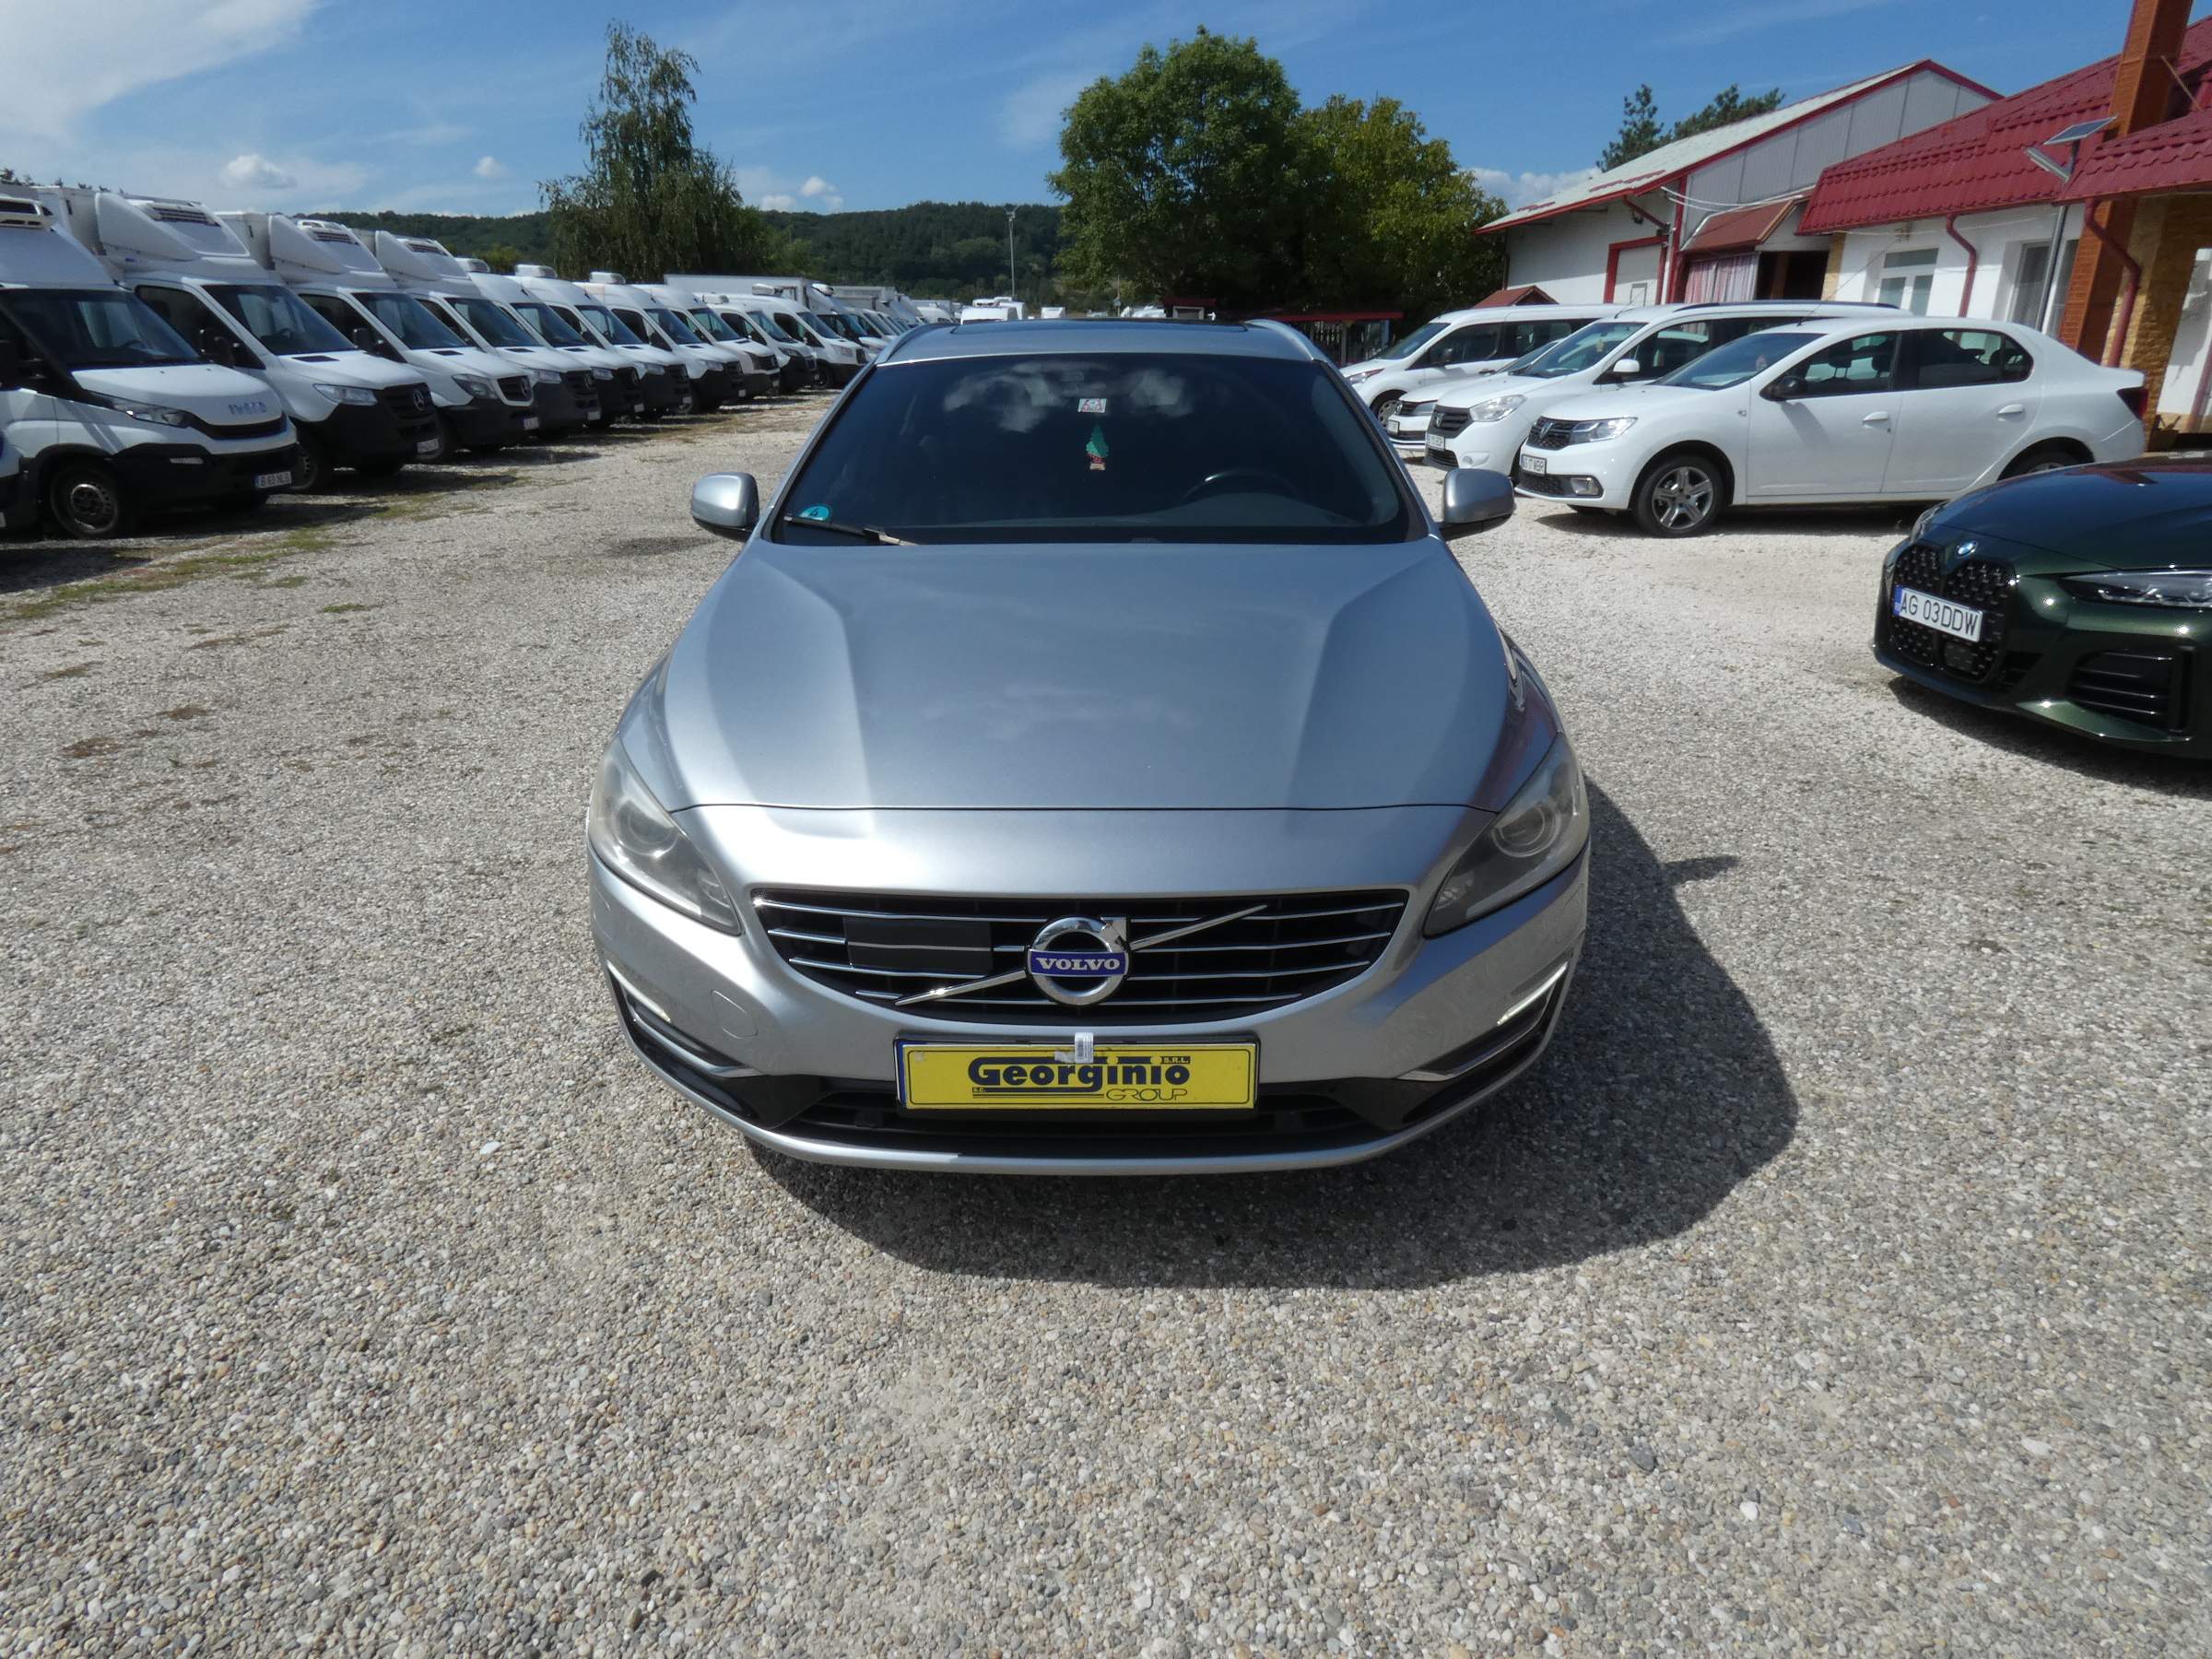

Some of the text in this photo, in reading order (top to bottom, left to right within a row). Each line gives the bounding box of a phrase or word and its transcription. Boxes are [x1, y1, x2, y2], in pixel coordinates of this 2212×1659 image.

[1900, 593, 1918, 616] AG
[1035, 958, 1121, 971] VOLVO
[968, 1056, 1191, 1092] Georginio
[1106, 1088, 1188, 1101] GROUP
